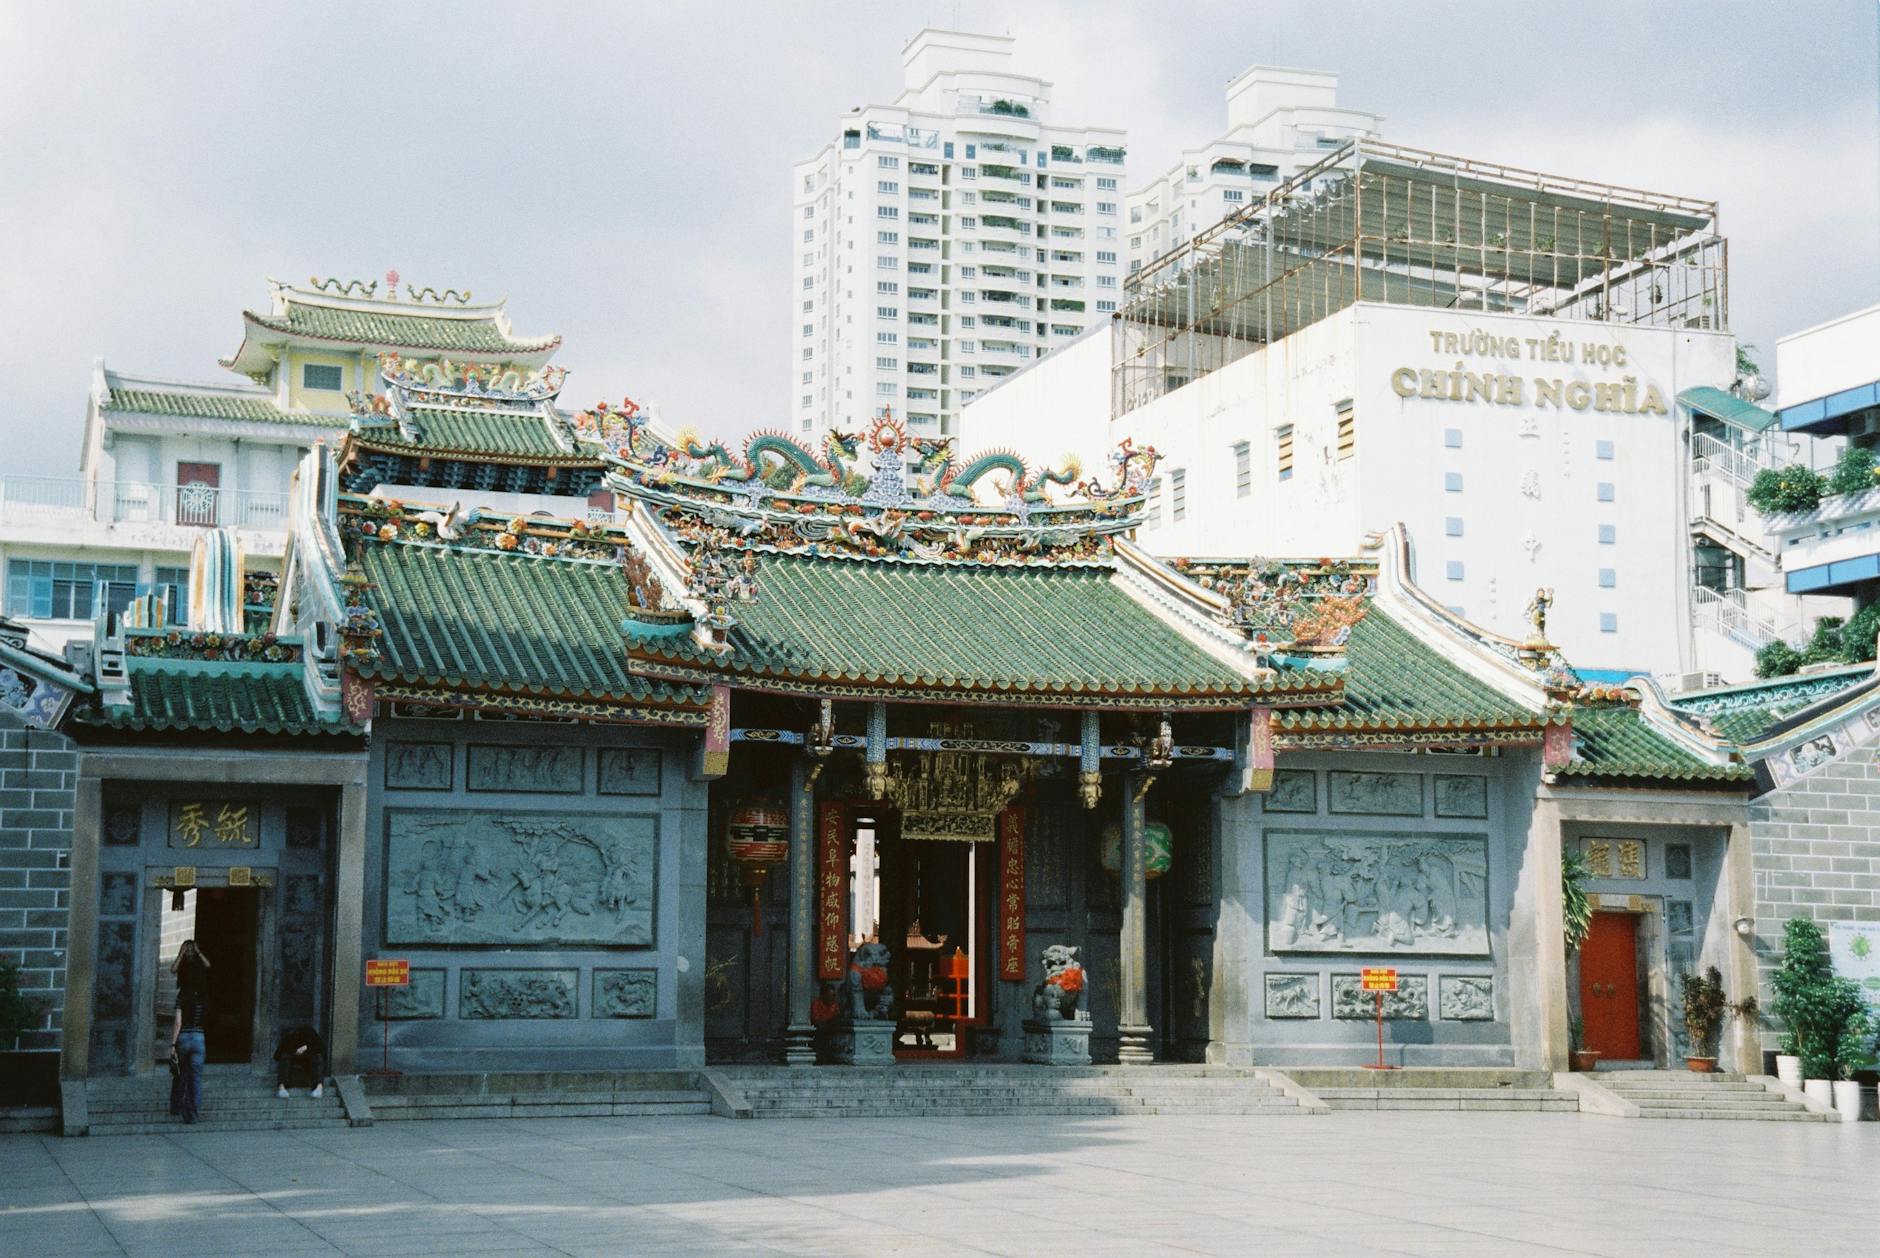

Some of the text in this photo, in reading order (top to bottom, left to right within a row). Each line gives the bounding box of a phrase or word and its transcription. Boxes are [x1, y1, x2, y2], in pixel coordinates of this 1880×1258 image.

[1430, 328, 1627, 371] TRƯỜNG TIỂU HỌC
[1391, 361, 1668, 414] CHÍNH NGHĨA
